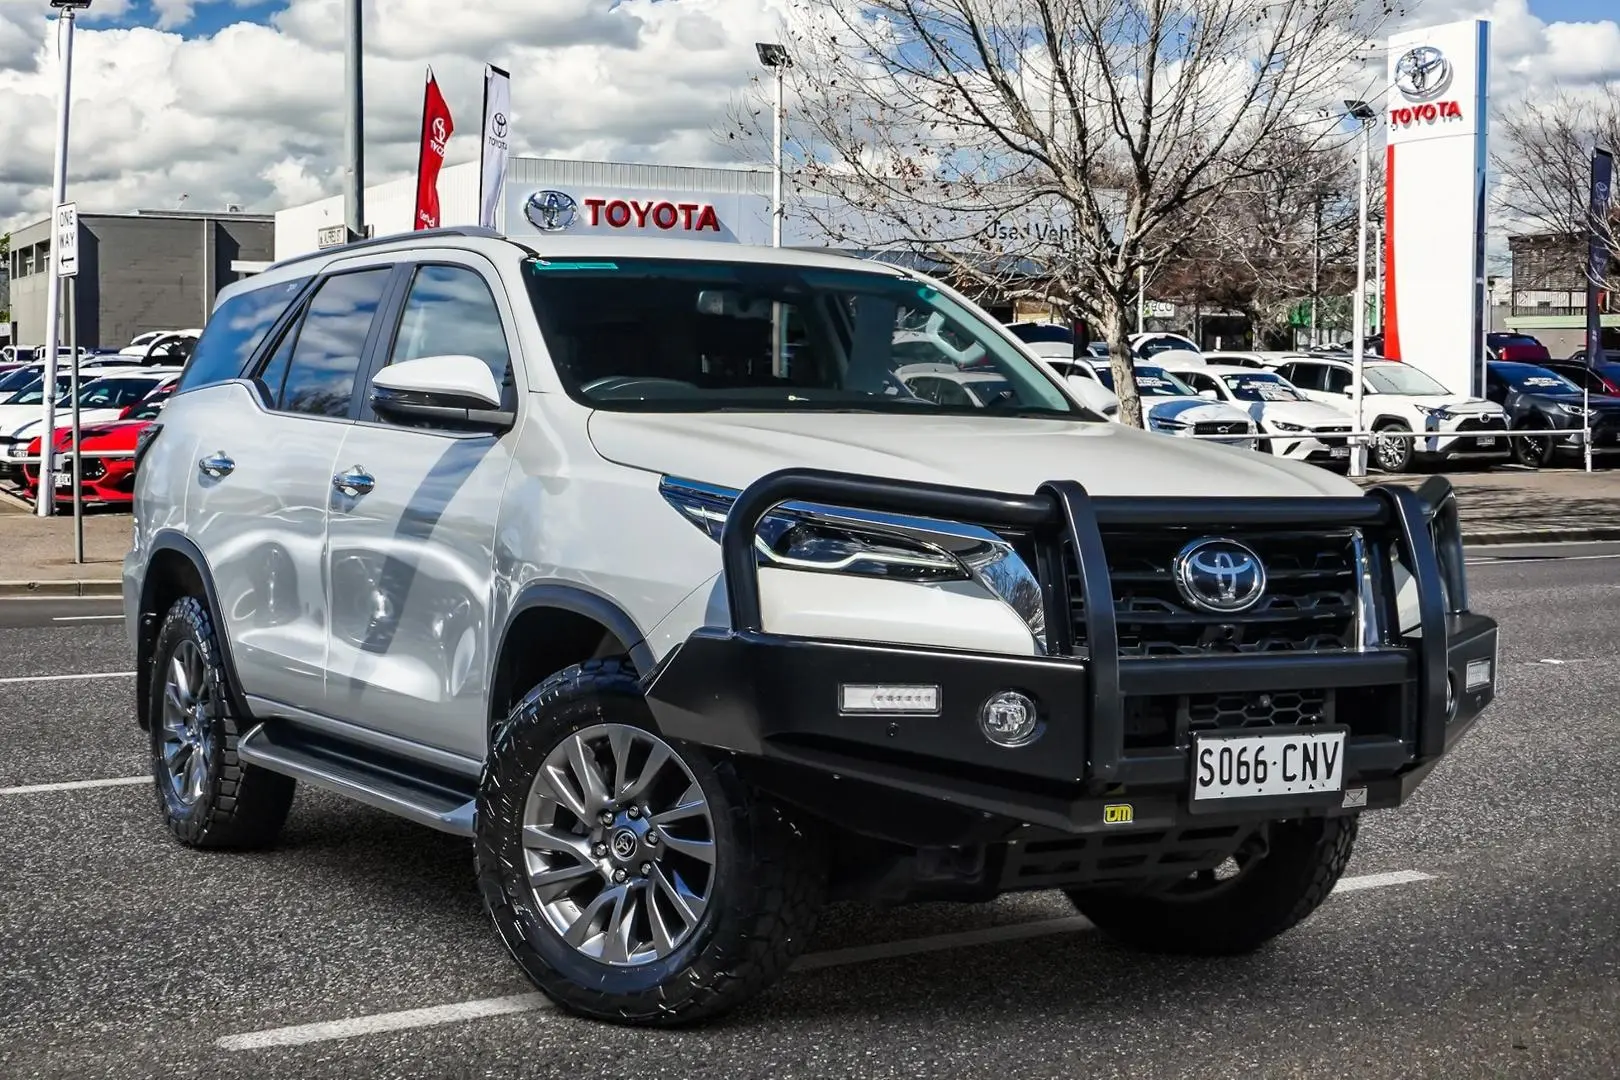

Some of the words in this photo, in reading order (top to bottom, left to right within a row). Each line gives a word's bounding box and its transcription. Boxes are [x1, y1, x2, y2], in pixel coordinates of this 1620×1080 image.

[1389, 101, 1462, 125] TOYOTA
[489, 136, 508, 151] TOYOTA
[60, 209, 74, 227] ONE
[584, 198, 721, 232] TOYOTA
[60, 231, 75, 249] WAY
